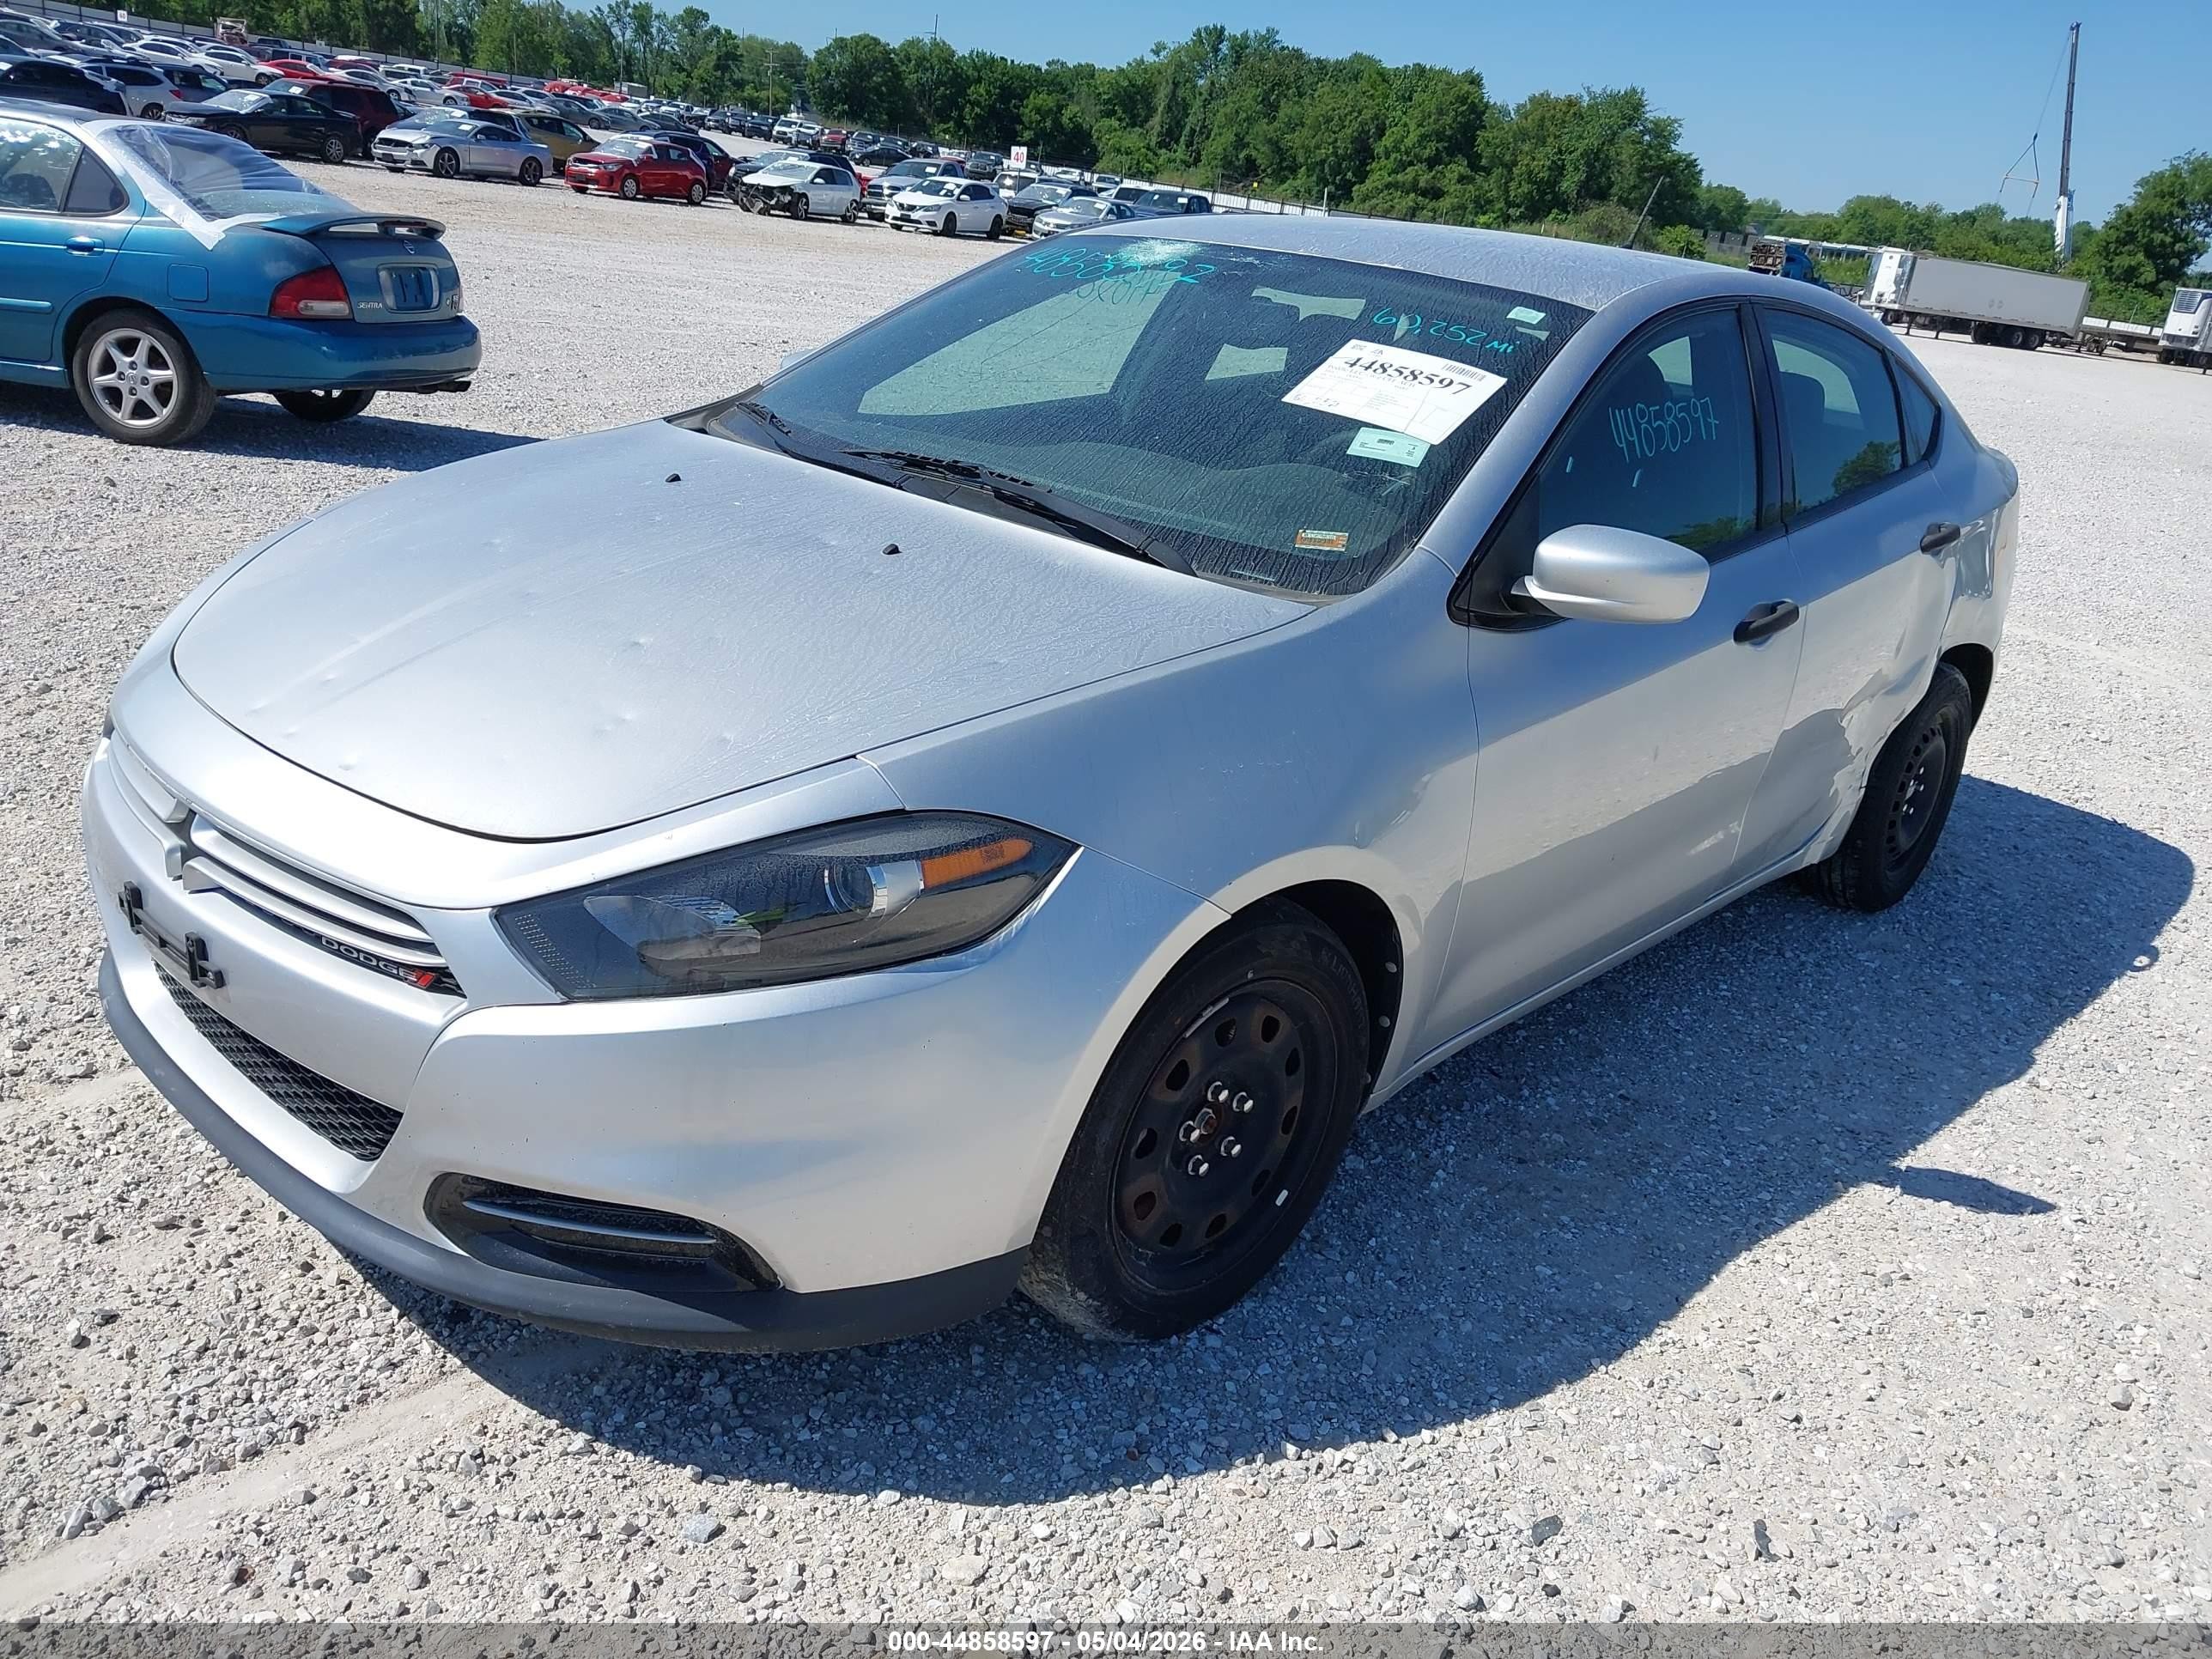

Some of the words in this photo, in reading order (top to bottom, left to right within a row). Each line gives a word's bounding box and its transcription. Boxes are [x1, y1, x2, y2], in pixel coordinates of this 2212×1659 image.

[1013, 151, 1024, 163] 40
[1374, 307, 1487, 345] 60,252
[1344, 356, 1474, 395] 44858597
[1608, 397, 1719, 464] 44858597
[321, 937, 417, 981] DODGE
